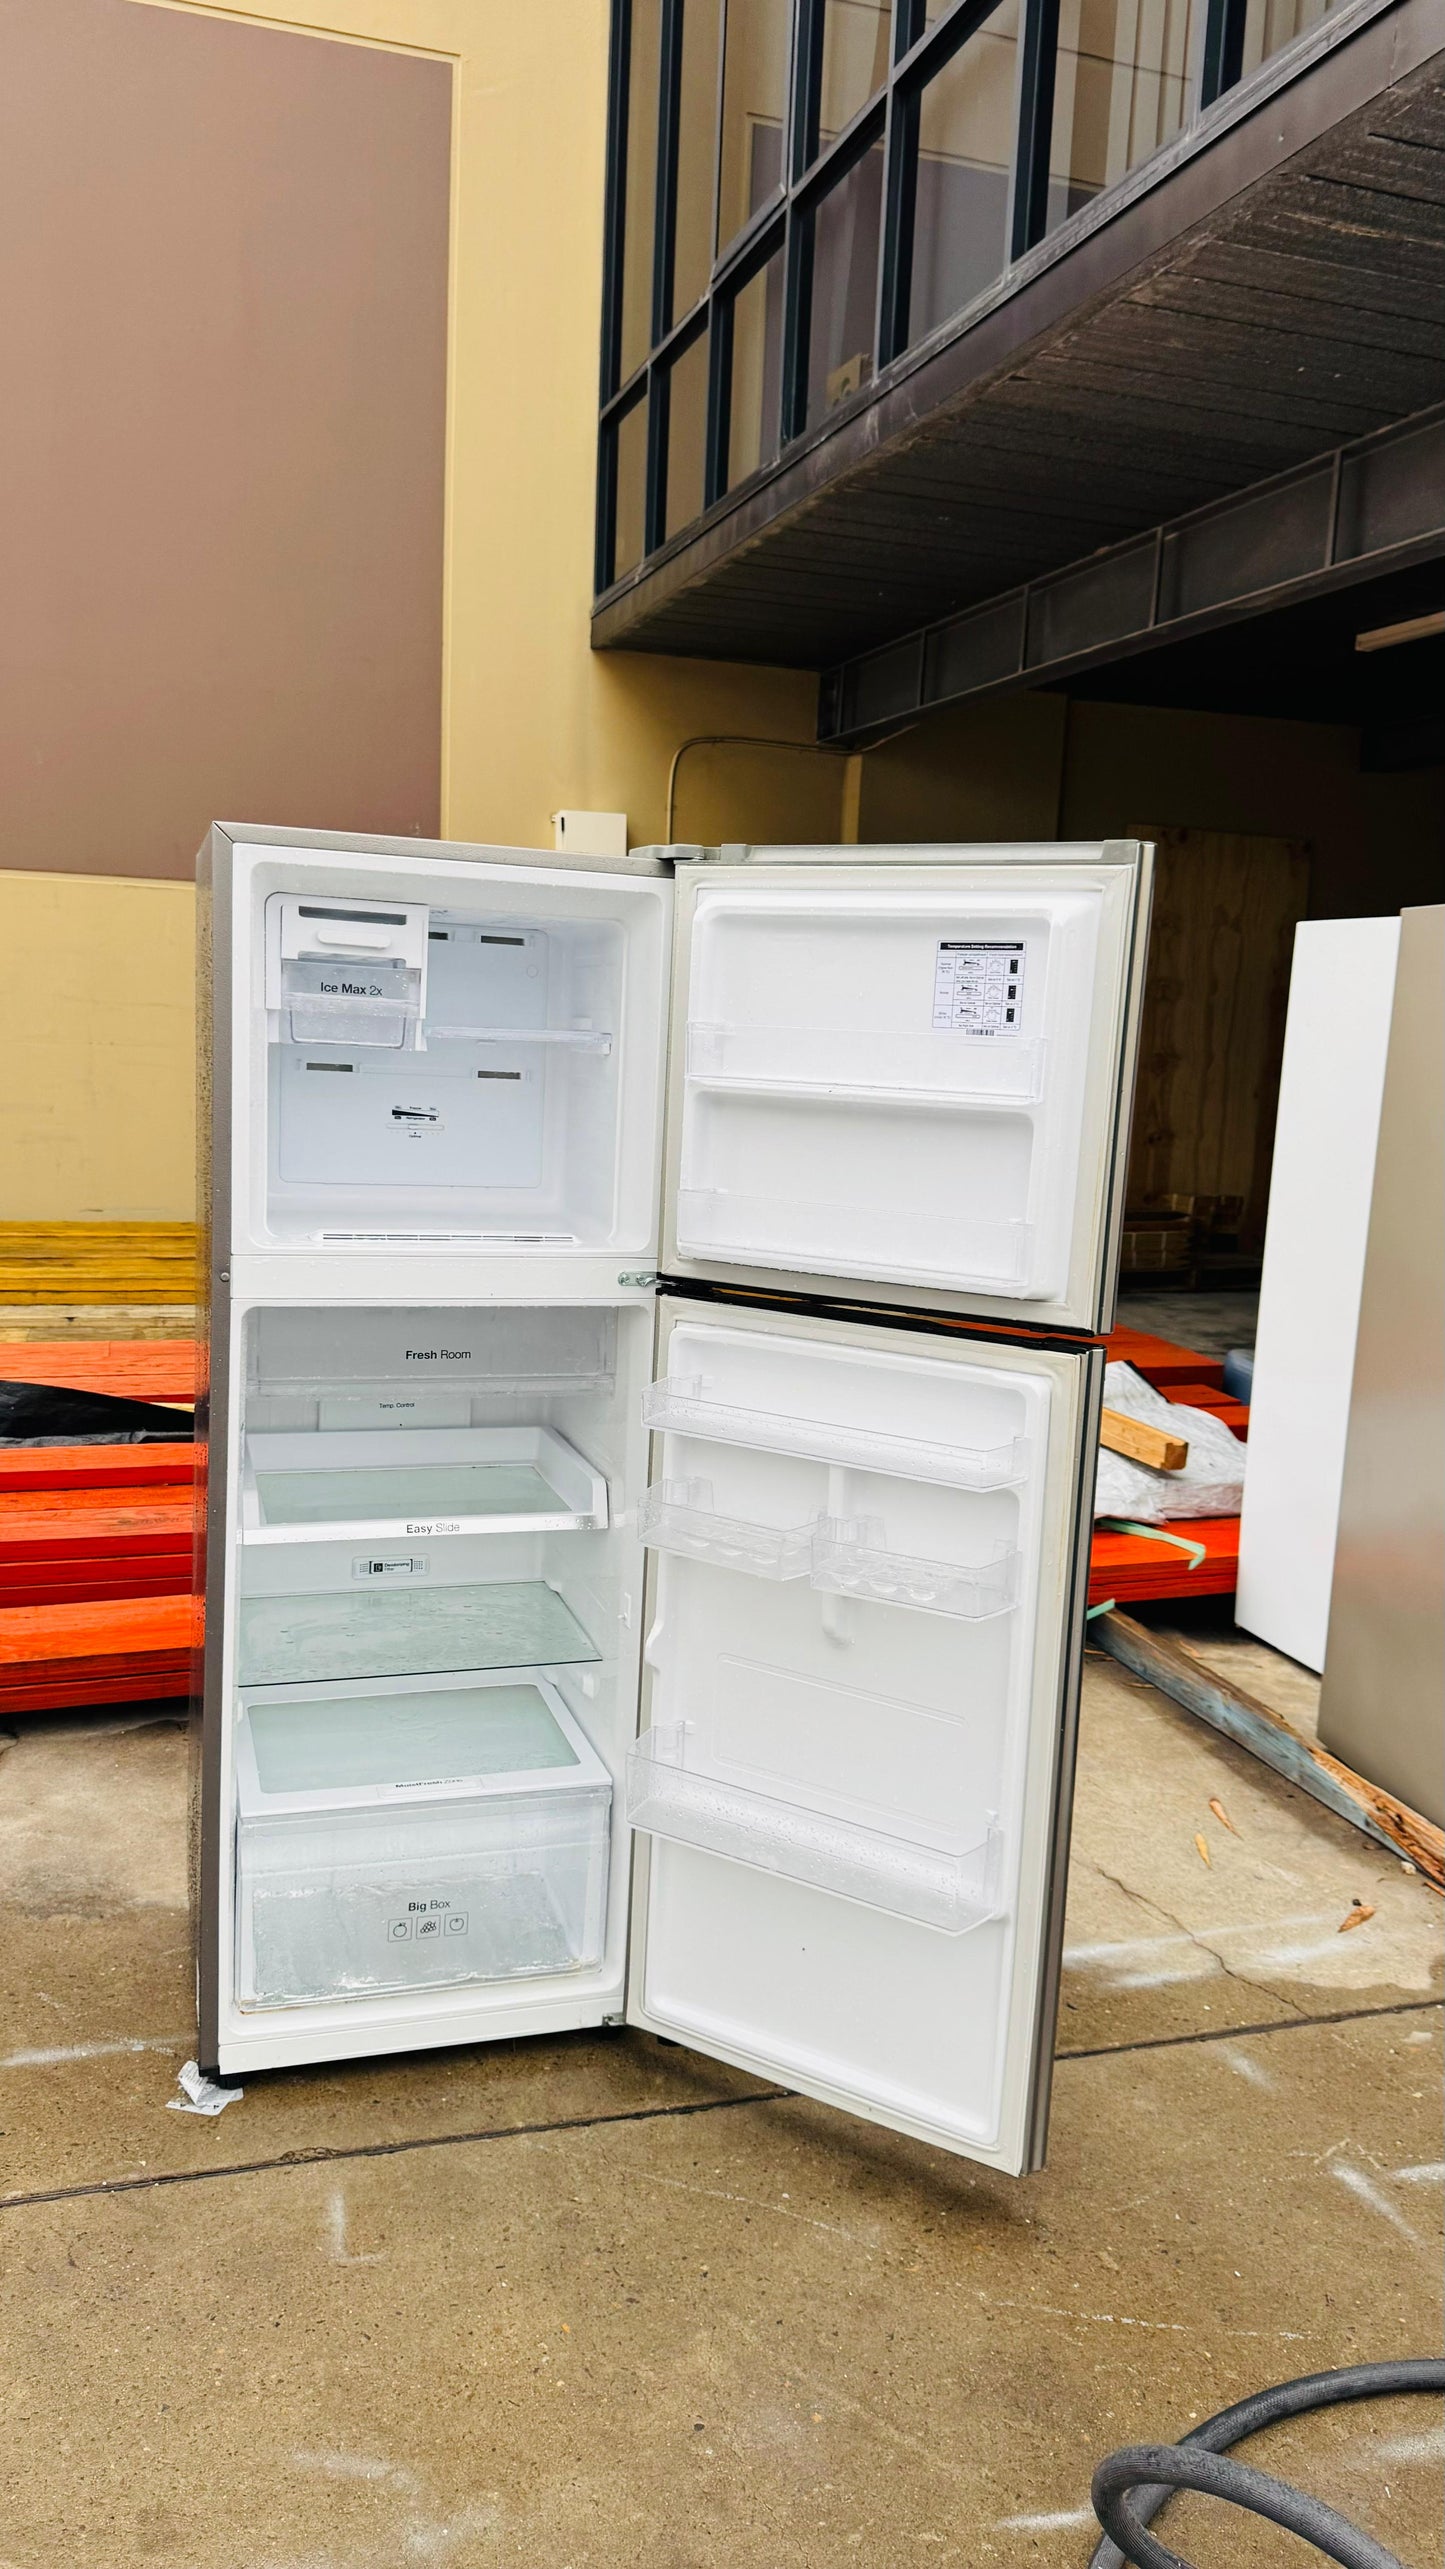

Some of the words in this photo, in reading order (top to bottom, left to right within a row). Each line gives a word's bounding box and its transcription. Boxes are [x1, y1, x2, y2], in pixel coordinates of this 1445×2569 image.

[321, 982, 338, 992] Ice
[341, 983, 367, 995] Max
[369, 985, 383, 996] 2x
[405, 1350, 437, 1360] Fresh
[440, 1349, 471, 1360] Room
[406, 1523, 433, 1534] Easy
[435, 1522, 460, 1533] Slide
[408, 1901, 427, 1912] Big
[430, 1899, 451, 1909] Box
